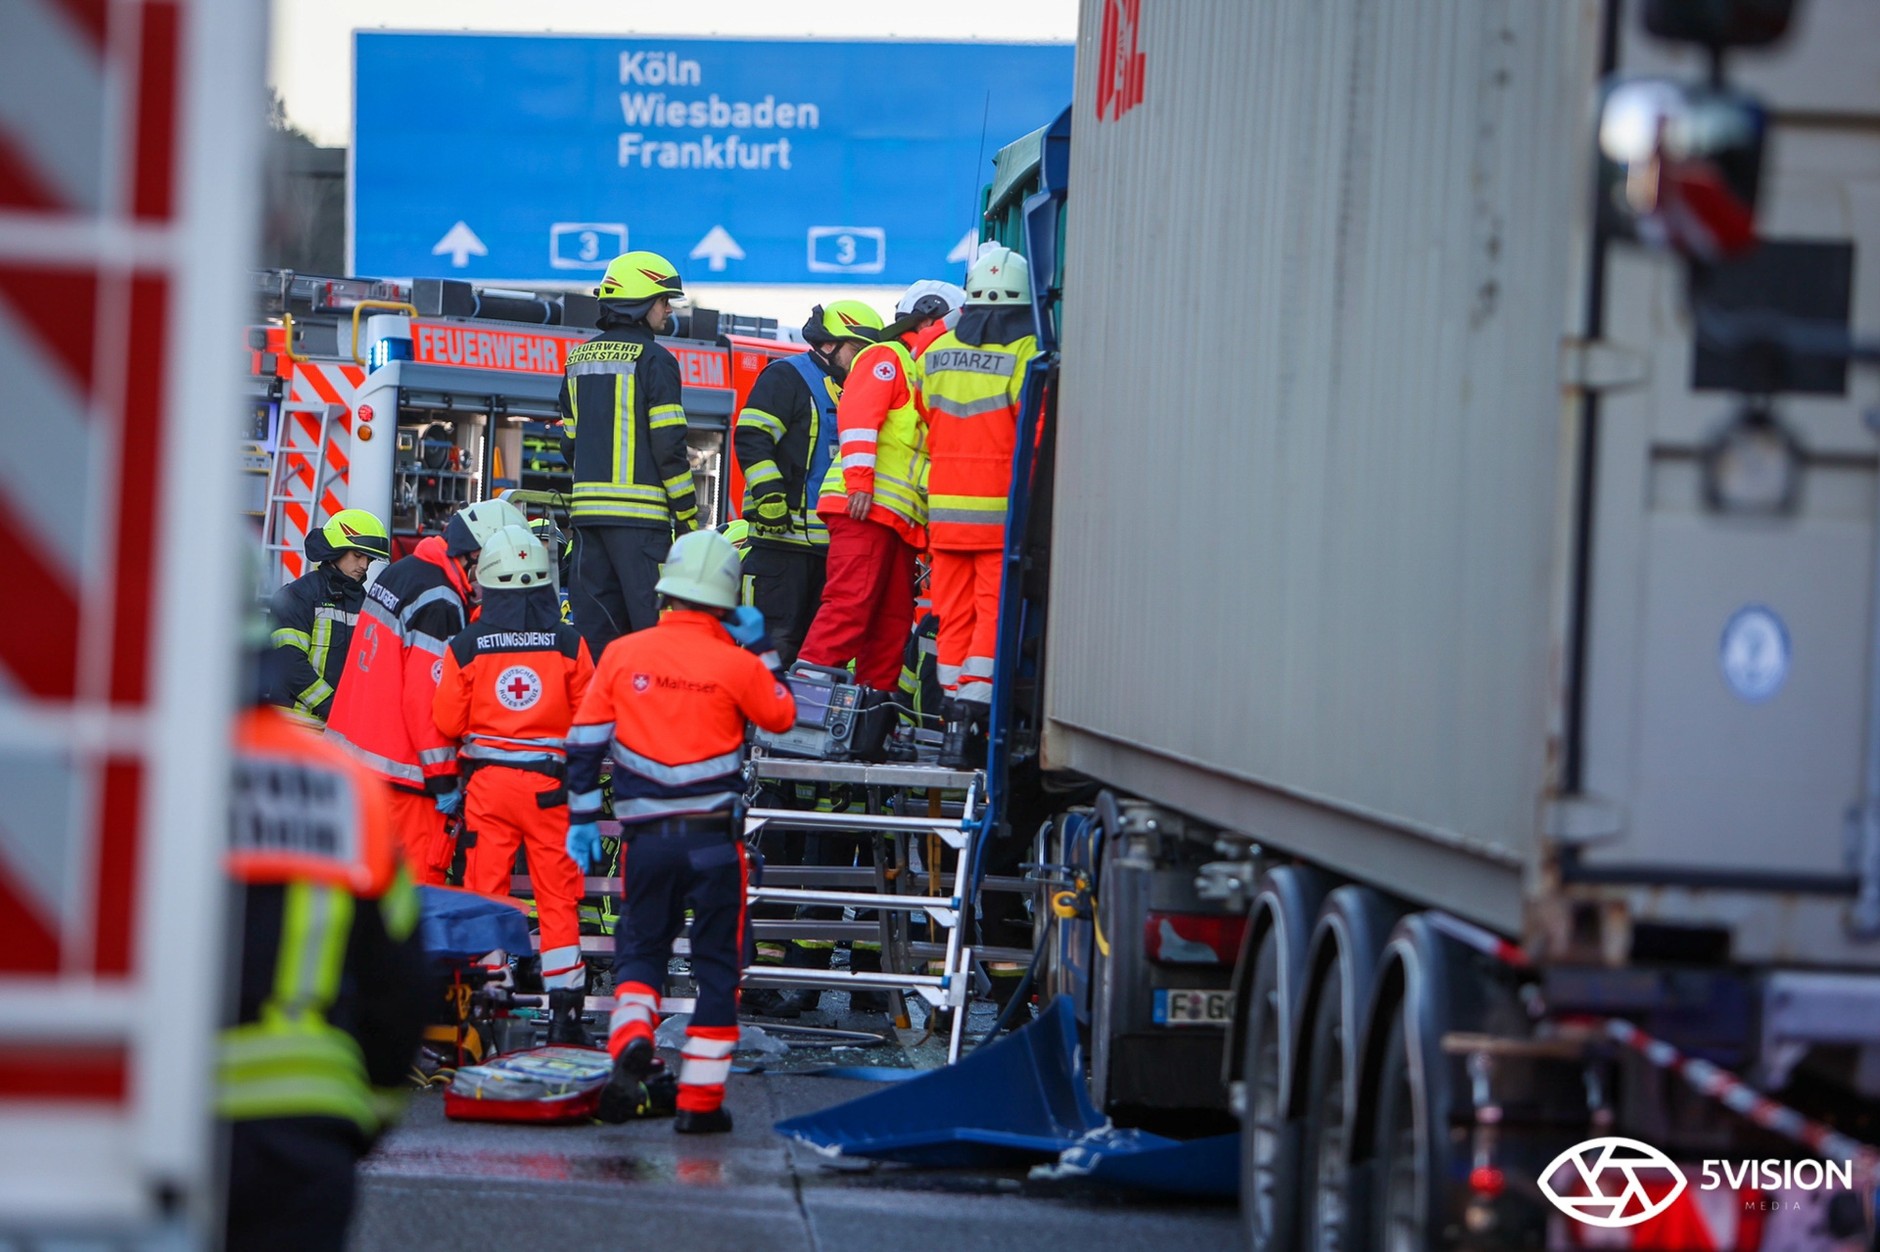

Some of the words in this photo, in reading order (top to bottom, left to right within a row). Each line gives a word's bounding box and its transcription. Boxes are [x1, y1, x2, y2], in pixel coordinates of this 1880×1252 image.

[619, 51, 701, 86] Köln
[619, 91, 819, 128] Wiesbaden
[618, 133, 792, 170] Frankfurt
[578, 231, 599, 261] 3
[836, 235, 857, 264] 3
[418, 327, 560, 372] FEUERWEHR
[567, 351, 638, 363] STOCKSTADT
[932, 351, 1005, 371] NOTARZT
[476, 632, 557, 649] RETTUNGSDIENST
[500, 668, 537, 685] DEUTSCHES
[655, 675, 717, 693] Malteser
[500, 689, 518, 707] ROTES
[520, 688, 539, 707] KREUZ
[1171, 993, 1188, 1018] F
